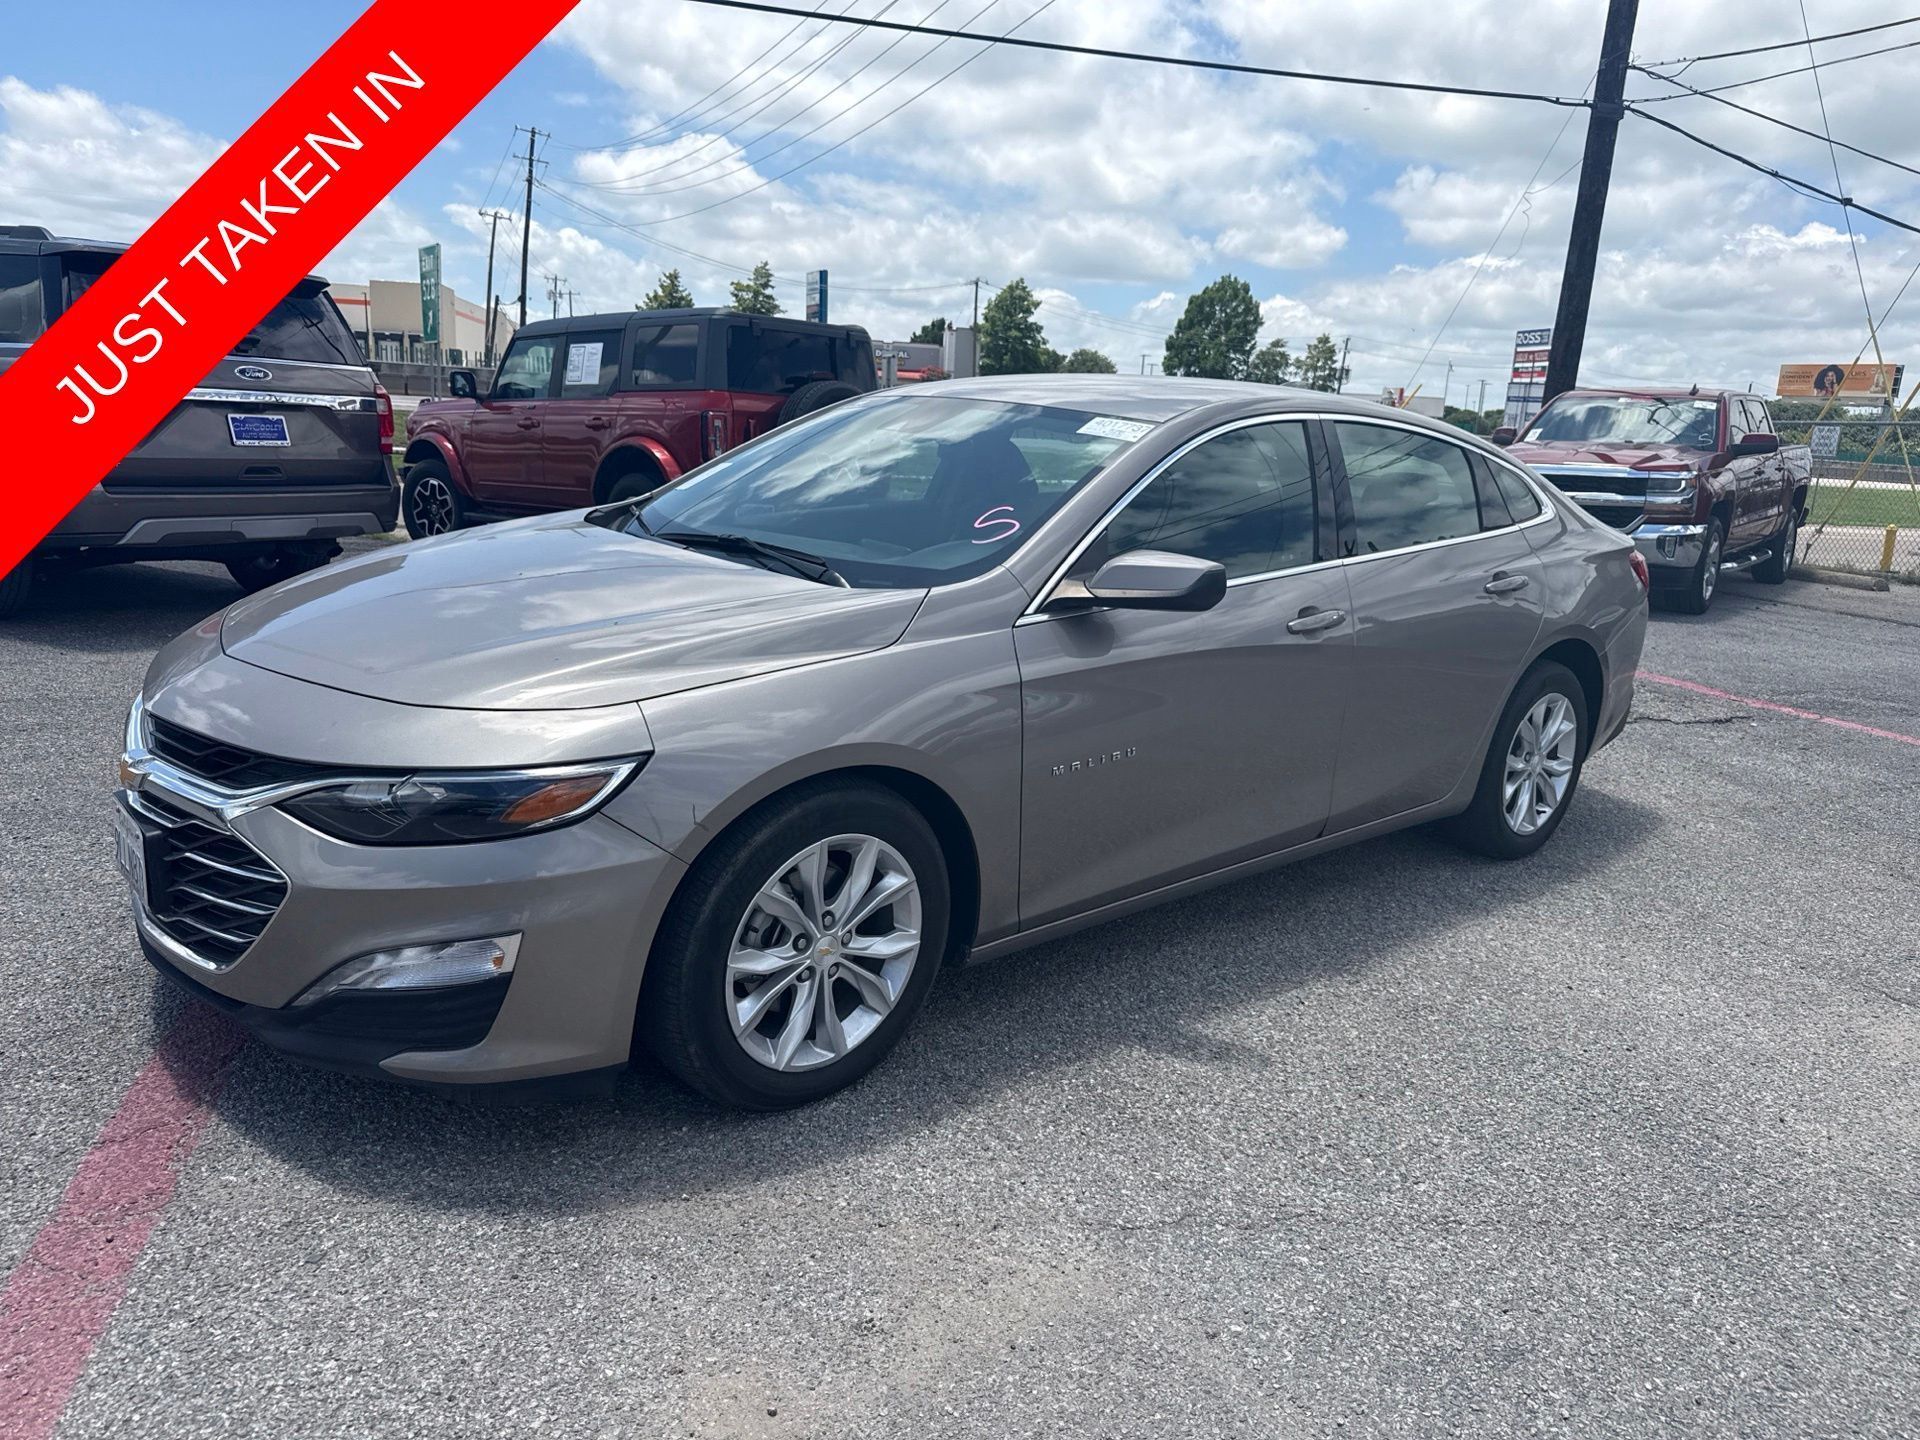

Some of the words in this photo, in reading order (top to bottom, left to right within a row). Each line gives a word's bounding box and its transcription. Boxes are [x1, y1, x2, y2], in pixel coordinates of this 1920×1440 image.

[1517, 332, 1540, 344] ROSS
[244, 368, 264, 378] Ford
[1051, 747, 1136, 776] MALIBU
